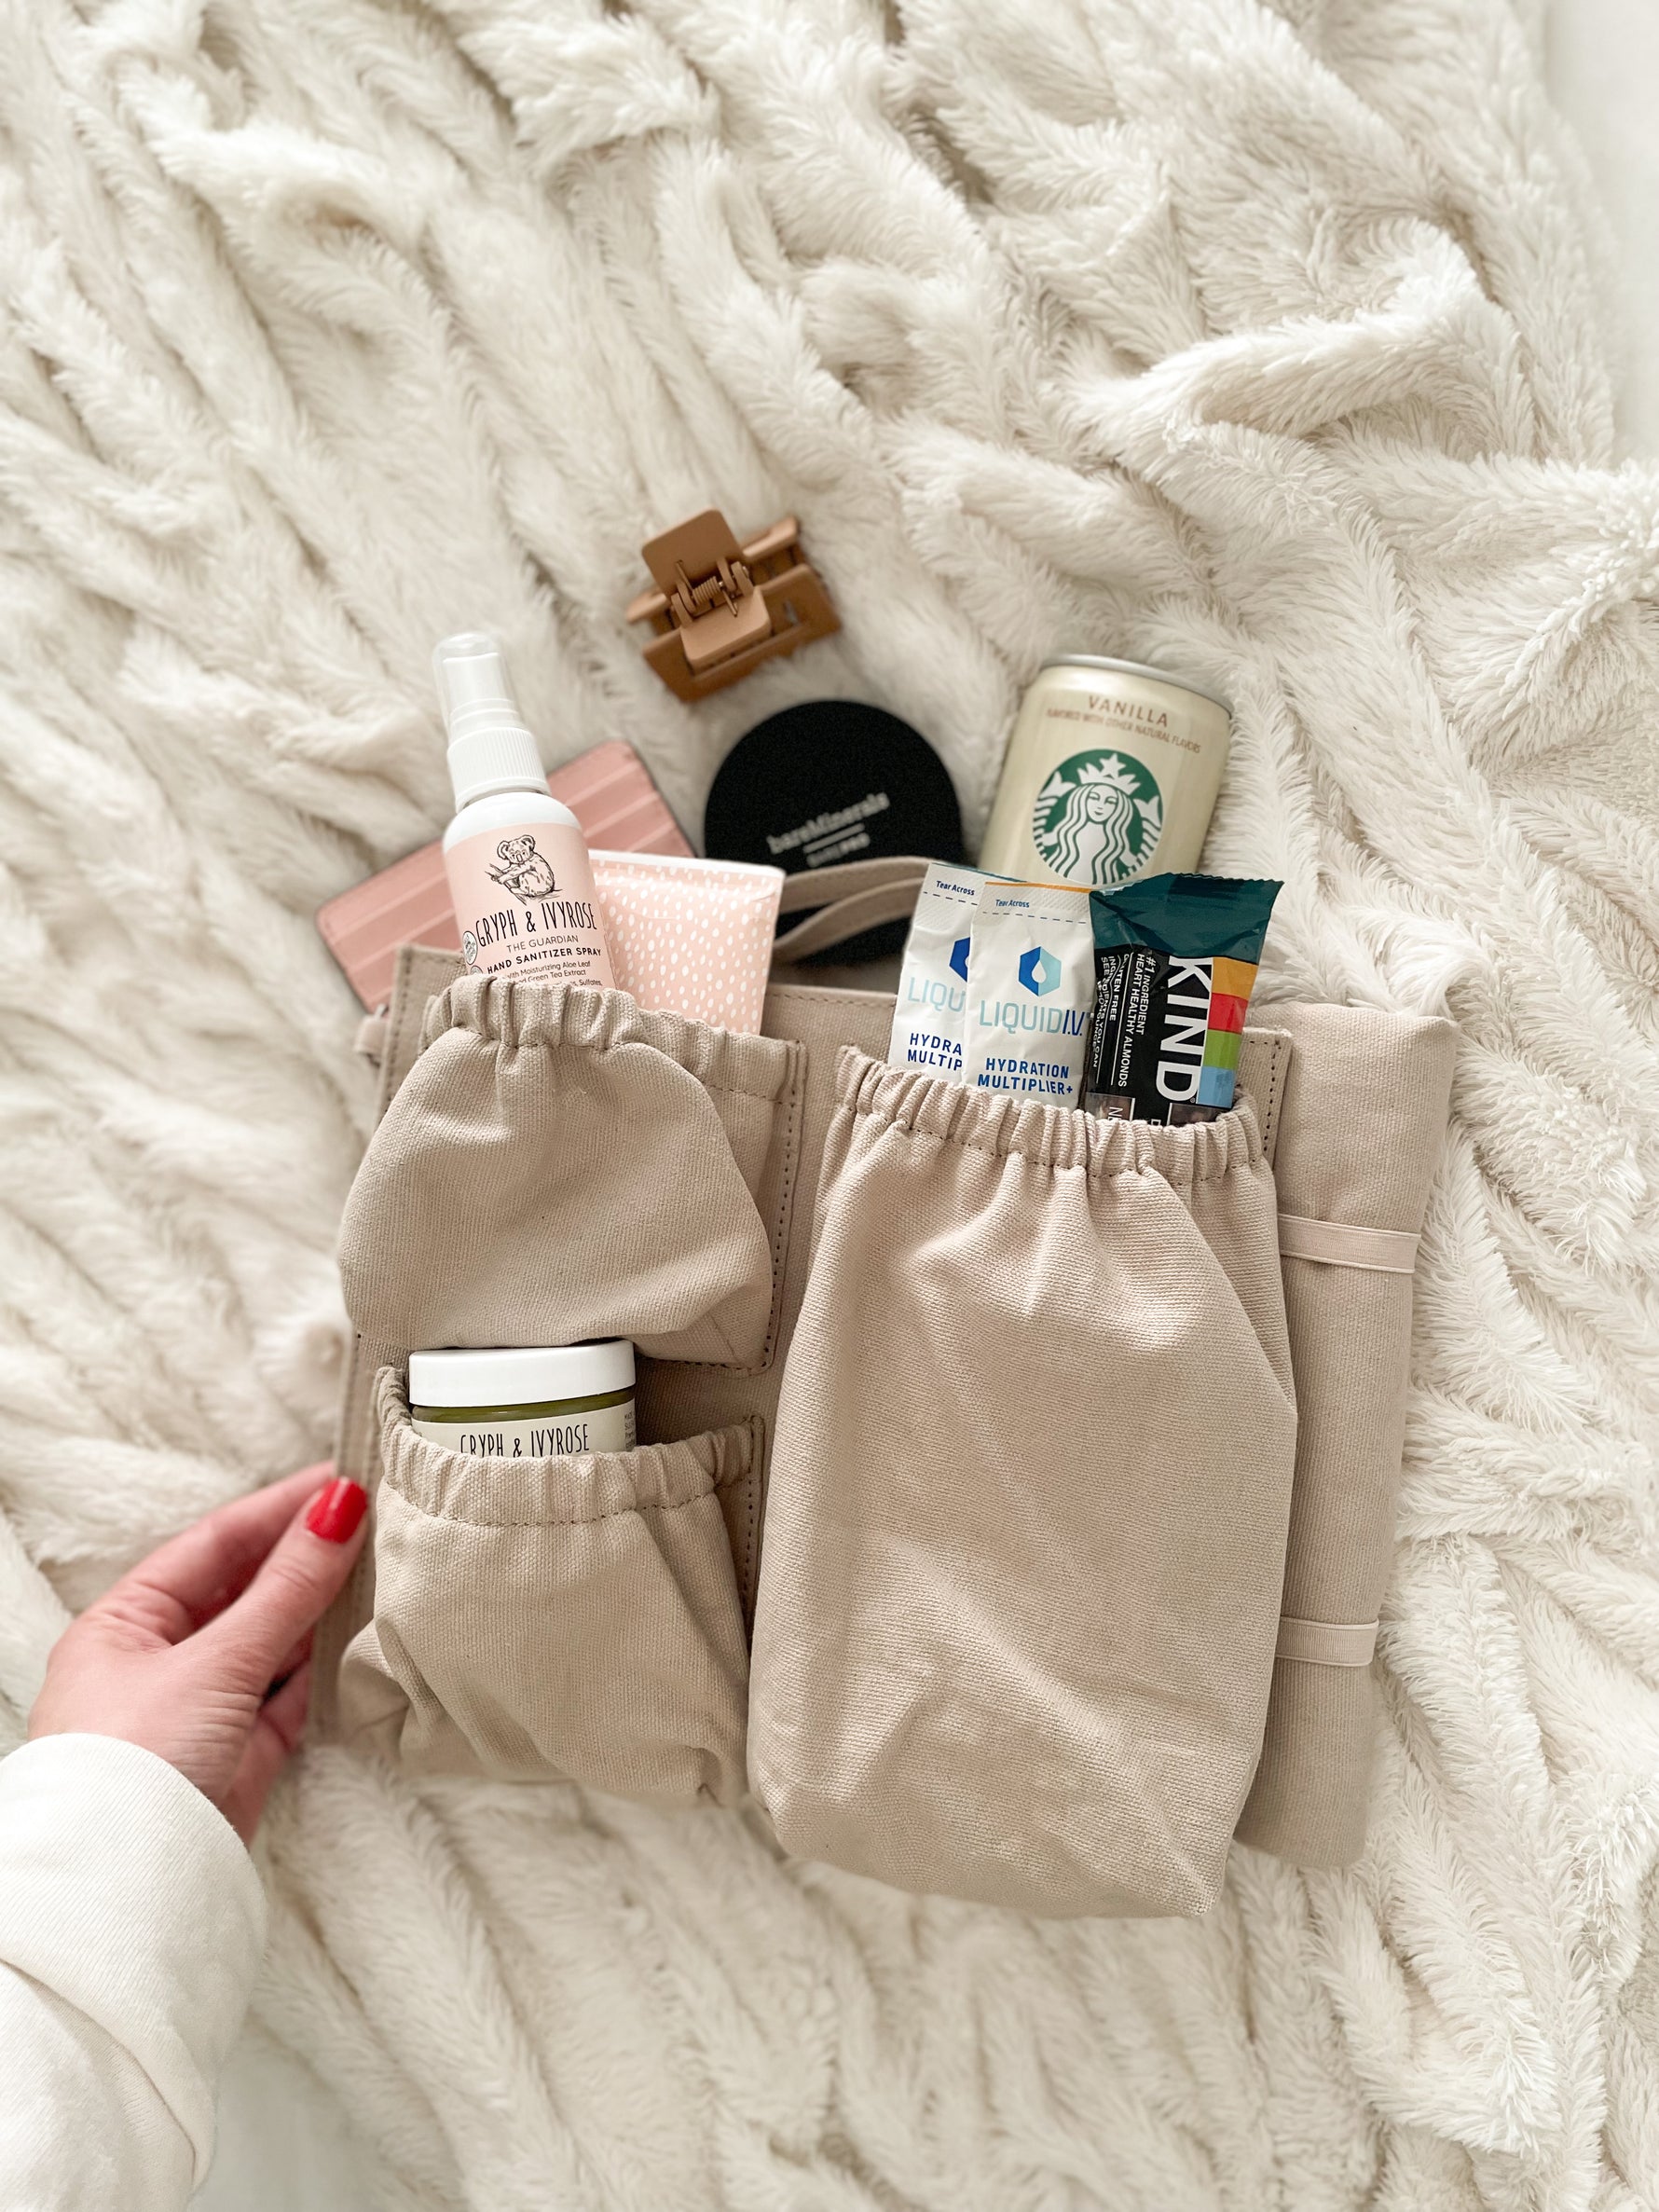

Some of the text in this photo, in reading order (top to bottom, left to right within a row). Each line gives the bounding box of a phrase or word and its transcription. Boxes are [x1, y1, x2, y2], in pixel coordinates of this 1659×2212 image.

[1089, 695, 1168, 727] VANILLA
[1134, 724, 1170, 743] NATURAL
[1172, 735, 1201, 753] FLAVORS
[936, 880, 975, 896] Tear Across
[995, 899, 1030, 908] Tear Across
[475, 900, 597, 947] GRYPH & IVYROSE
[506, 935, 579, 954] THE GUARDIAN
[487, 947, 602, 975] HAND SANITIZER SPRAY
[520, 963, 561, 976] Moisturizing
[564, 969, 586, 977] Extract
[1101, 956, 1110, 975] SEE
[1109, 995, 1118, 1021] FREE
[1135, 956, 1157, 1035] #1 INGREDIENT
[1118, 954, 1145, 1087] HEART HEALTHY ALMONDS
[1156, 955, 1213, 1102] KIND
[985, 1057, 1070, 1079] HYDRATION
[513, 1437, 522, 1457] &
[530, 1423, 590, 1457] IVYROSE
